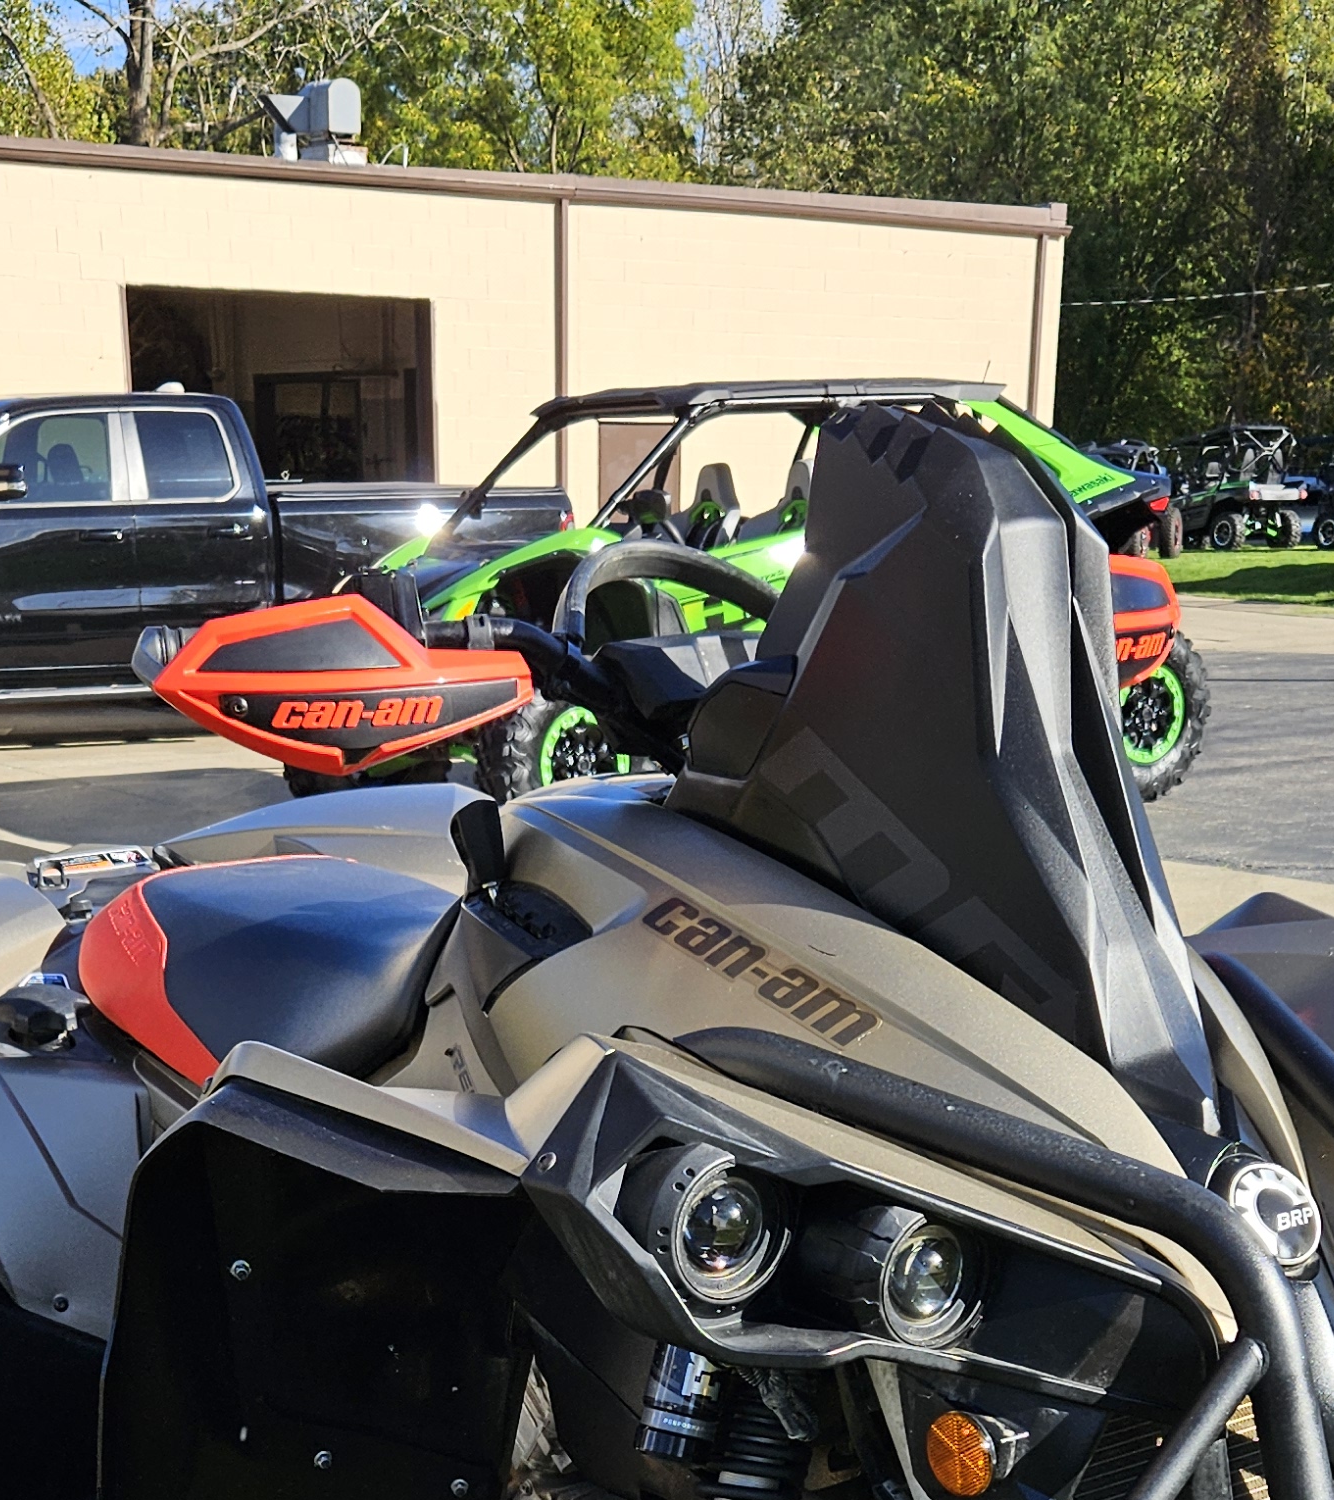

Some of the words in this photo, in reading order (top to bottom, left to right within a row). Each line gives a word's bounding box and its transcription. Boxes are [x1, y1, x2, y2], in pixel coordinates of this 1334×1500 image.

[1116, 632, 1166, 661] n-am
[271, 696, 443, 729] can-am
[642, 897, 878, 1046] can-am
[1277, 1207, 1314, 1231] BRP
